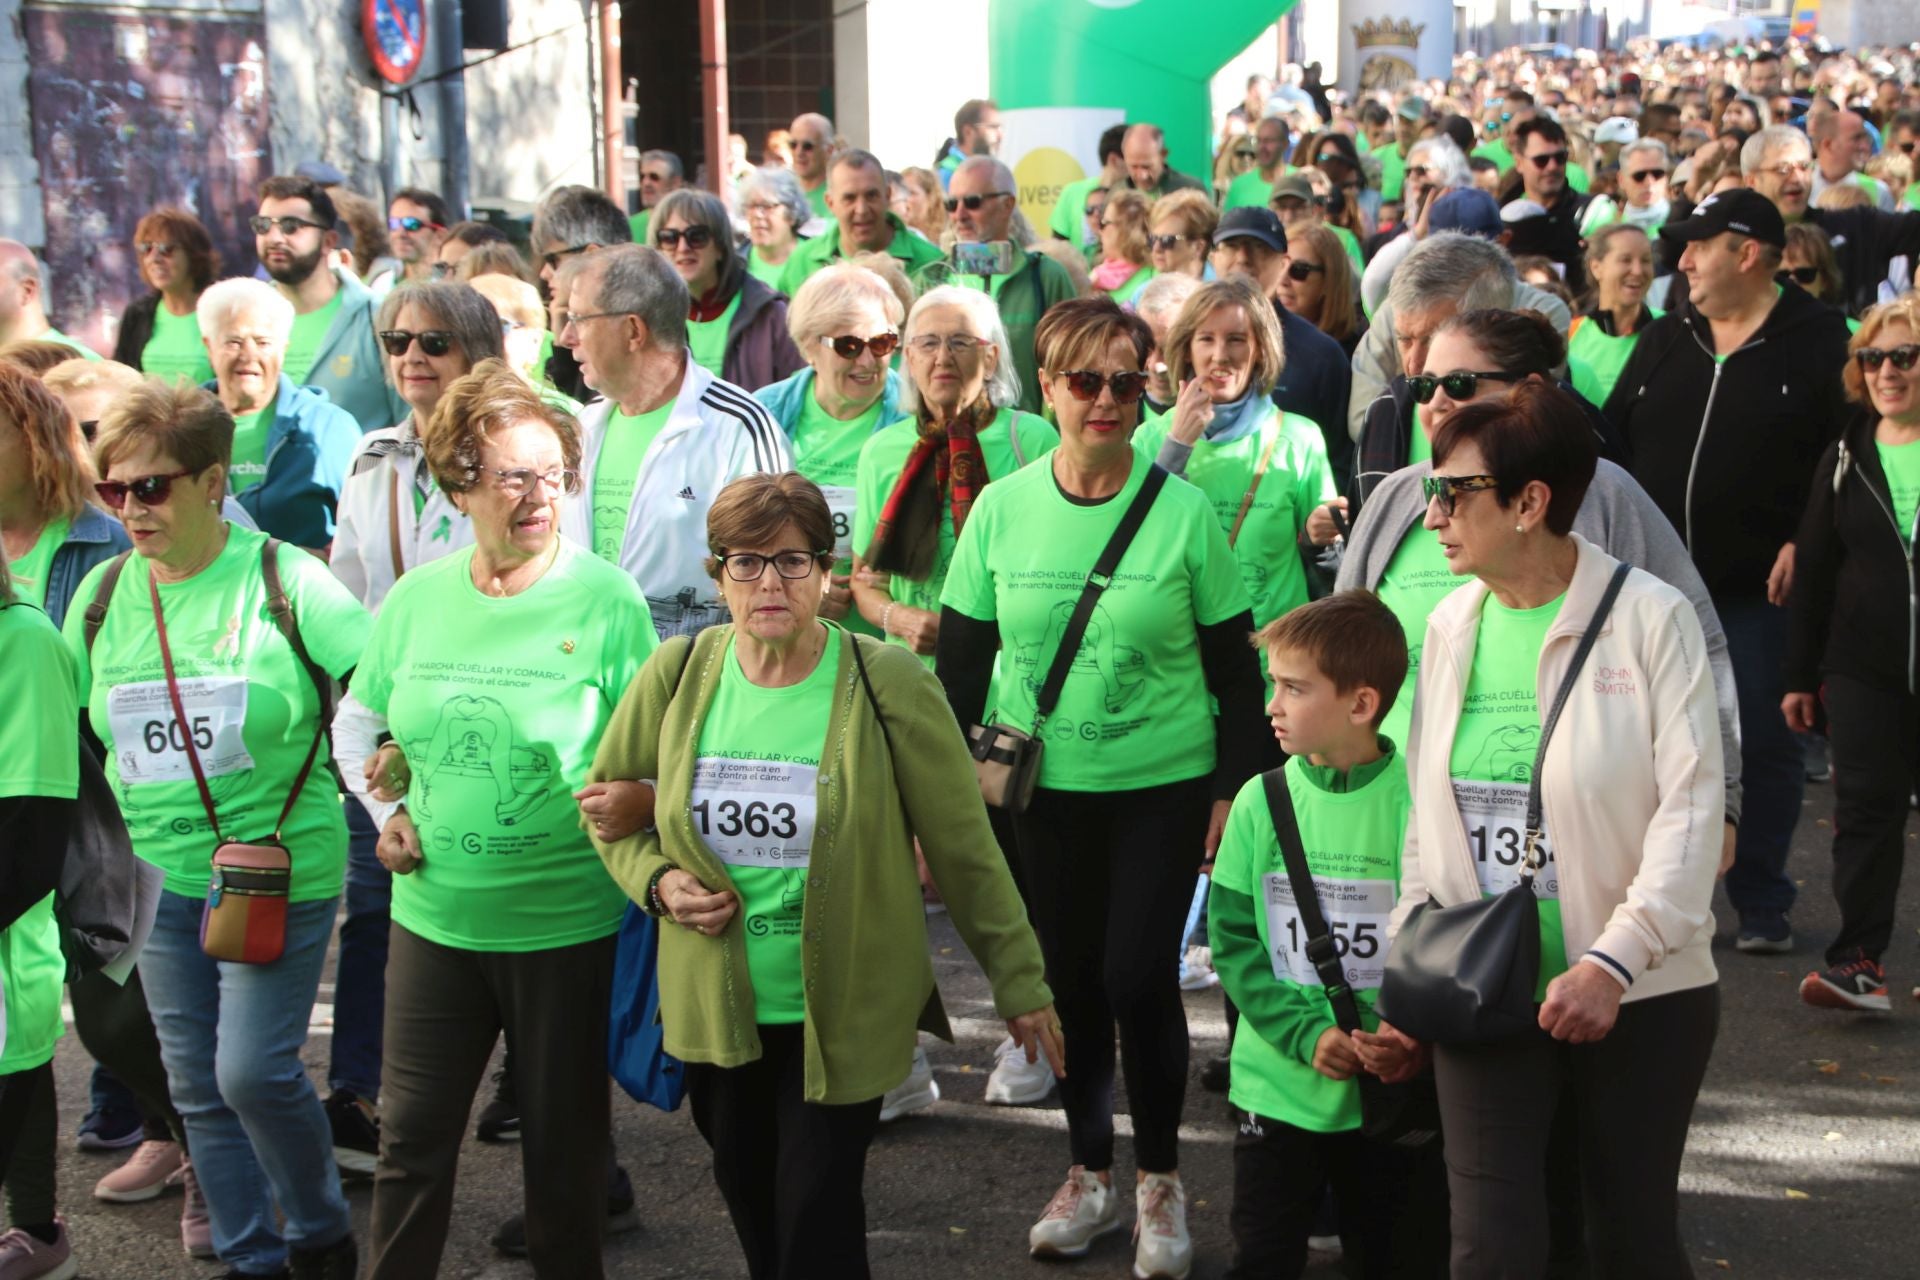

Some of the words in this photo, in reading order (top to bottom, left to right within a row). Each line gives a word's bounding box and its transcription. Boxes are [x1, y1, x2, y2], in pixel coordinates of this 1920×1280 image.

[1010, 571, 1017, 579] V
[1018, 571, 1056, 579] MARCHA
[1020, 581, 1053, 590] marcha
[418, 662, 455, 671] MARCHA
[456, 662, 504, 675] CUÉLLAR
[506, 667, 513, 675] Y
[514, 668, 567, 681] COMARCA
[452, 676, 484, 685] contra
[486, 677, 496, 686] el
[1593, 680, 1636, 695] SMITH
[1497, 704, 1529, 713] contra
[144, 716, 213, 754] 605
[730, 748, 781, 761] CUÉLLAR
[728, 764, 767, 773] comarca
[769, 766, 781, 774] en
[718, 771, 748, 781] contra
[749, 772, 758, 781] el
[1492, 788, 1498, 797] y
[1491, 796, 1523, 807] contra
[692, 799, 798, 839] 1363
[1470, 825, 1555, 870] 135
[1343, 884, 1356, 892] en
[1286, 917, 1379, 959] 155
